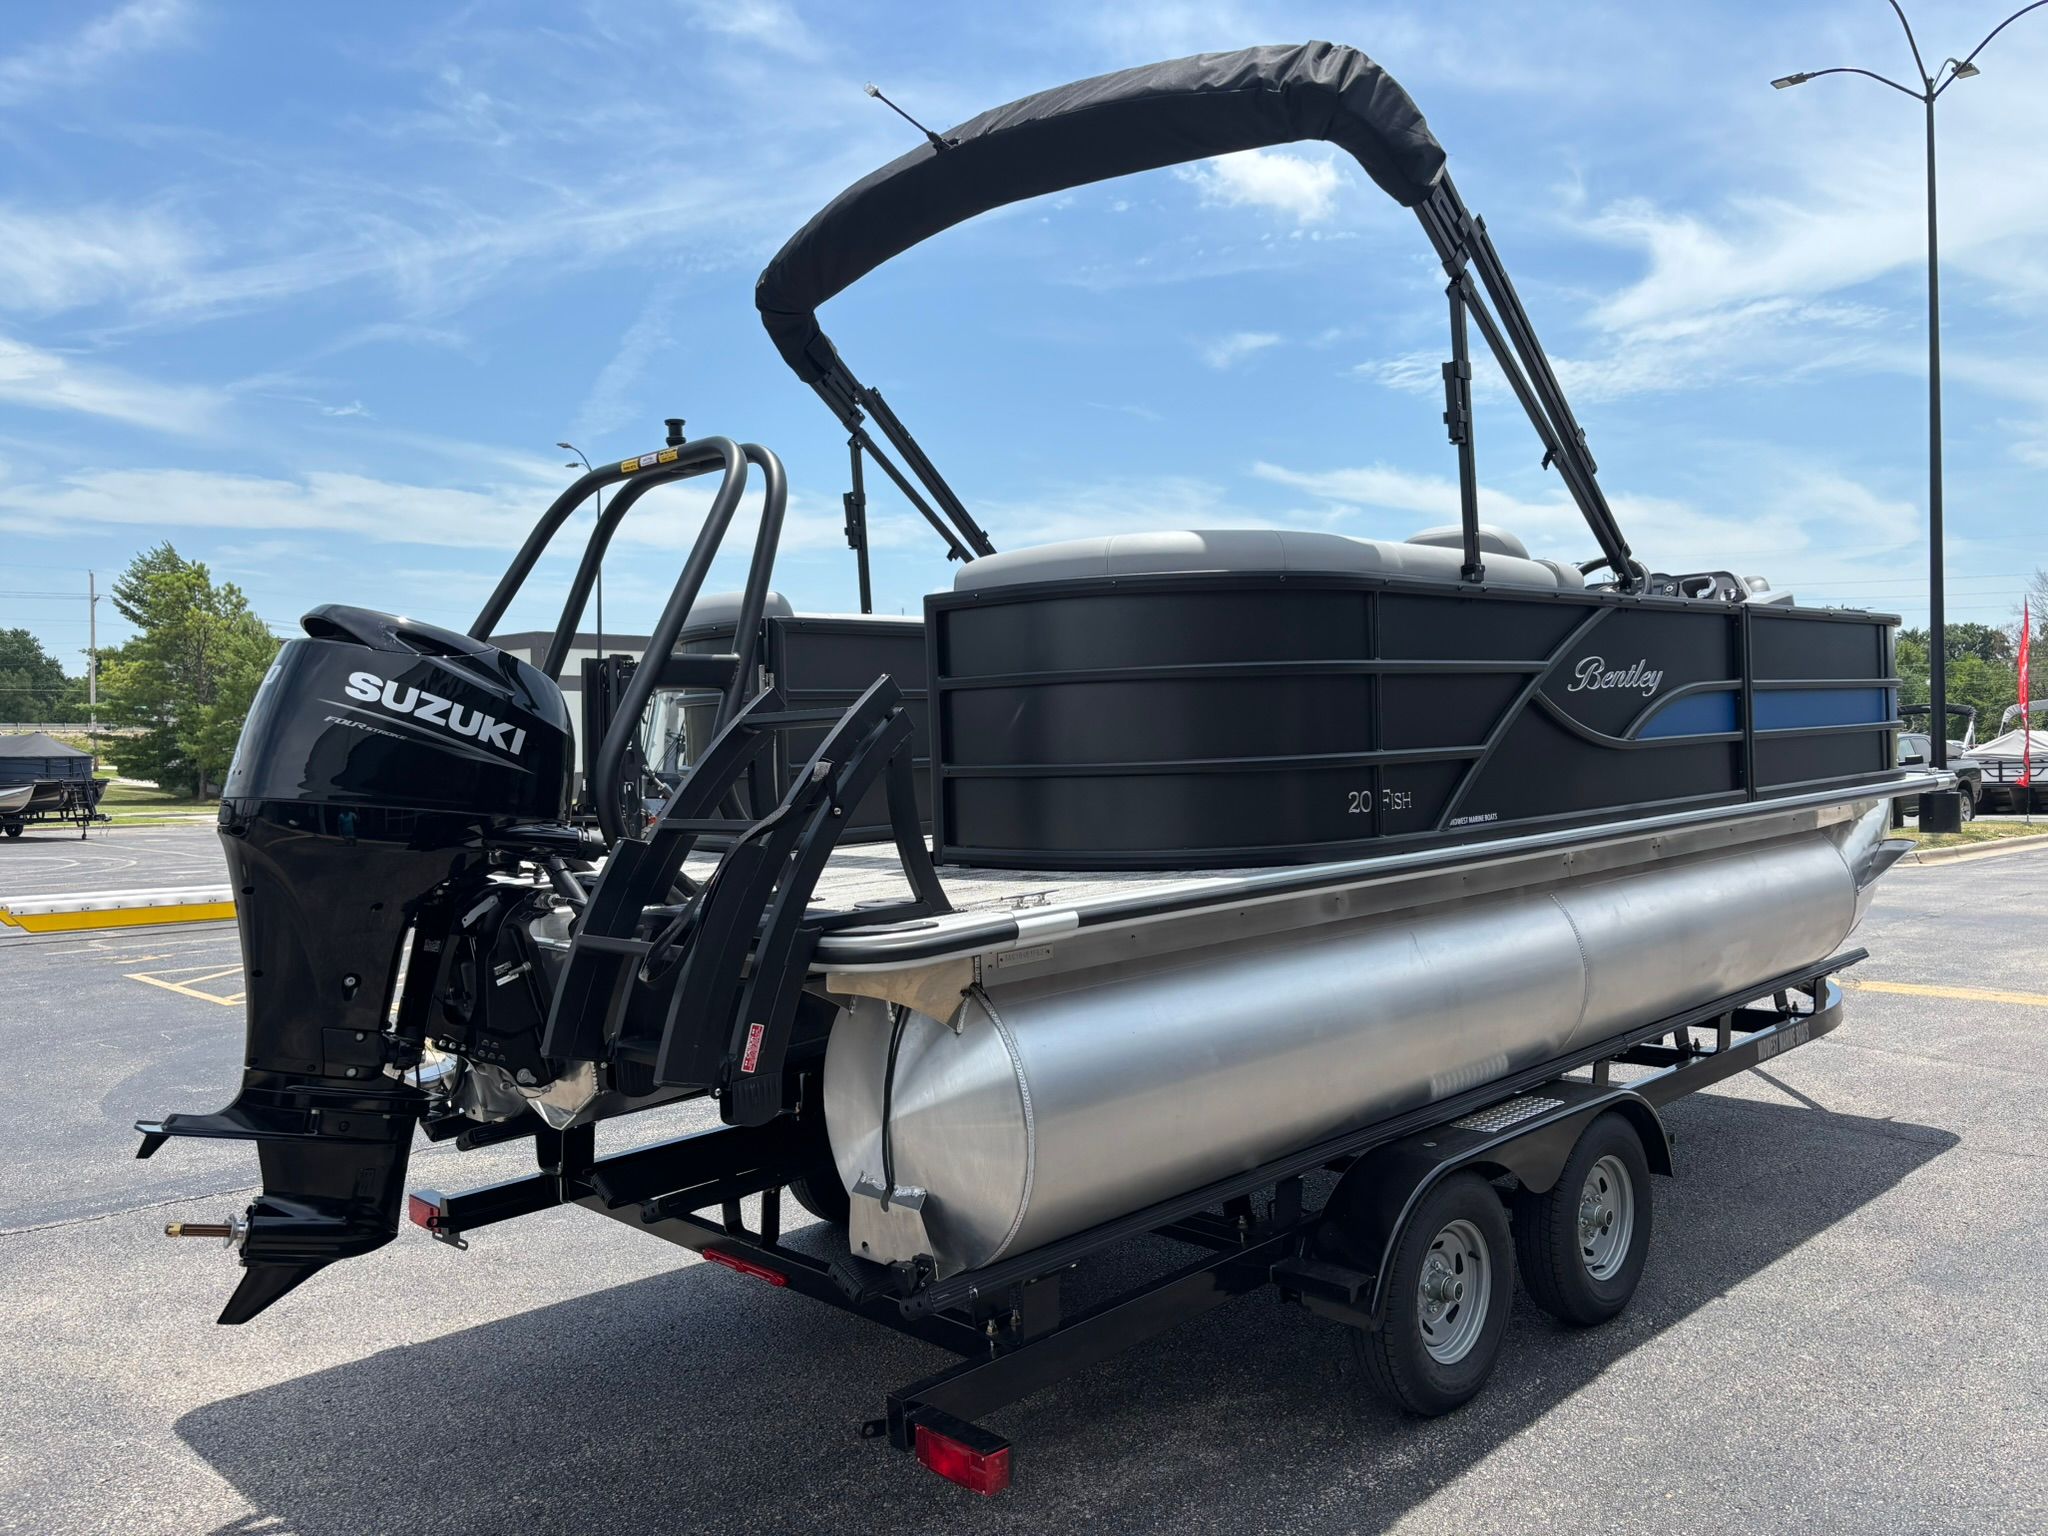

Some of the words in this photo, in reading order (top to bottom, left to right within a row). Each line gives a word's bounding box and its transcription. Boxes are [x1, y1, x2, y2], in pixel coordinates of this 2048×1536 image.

[1567, 656, 1664, 697] Bentley
[345, 671, 527, 756] SUZUKI
[1348, 790, 1372, 813] 20
